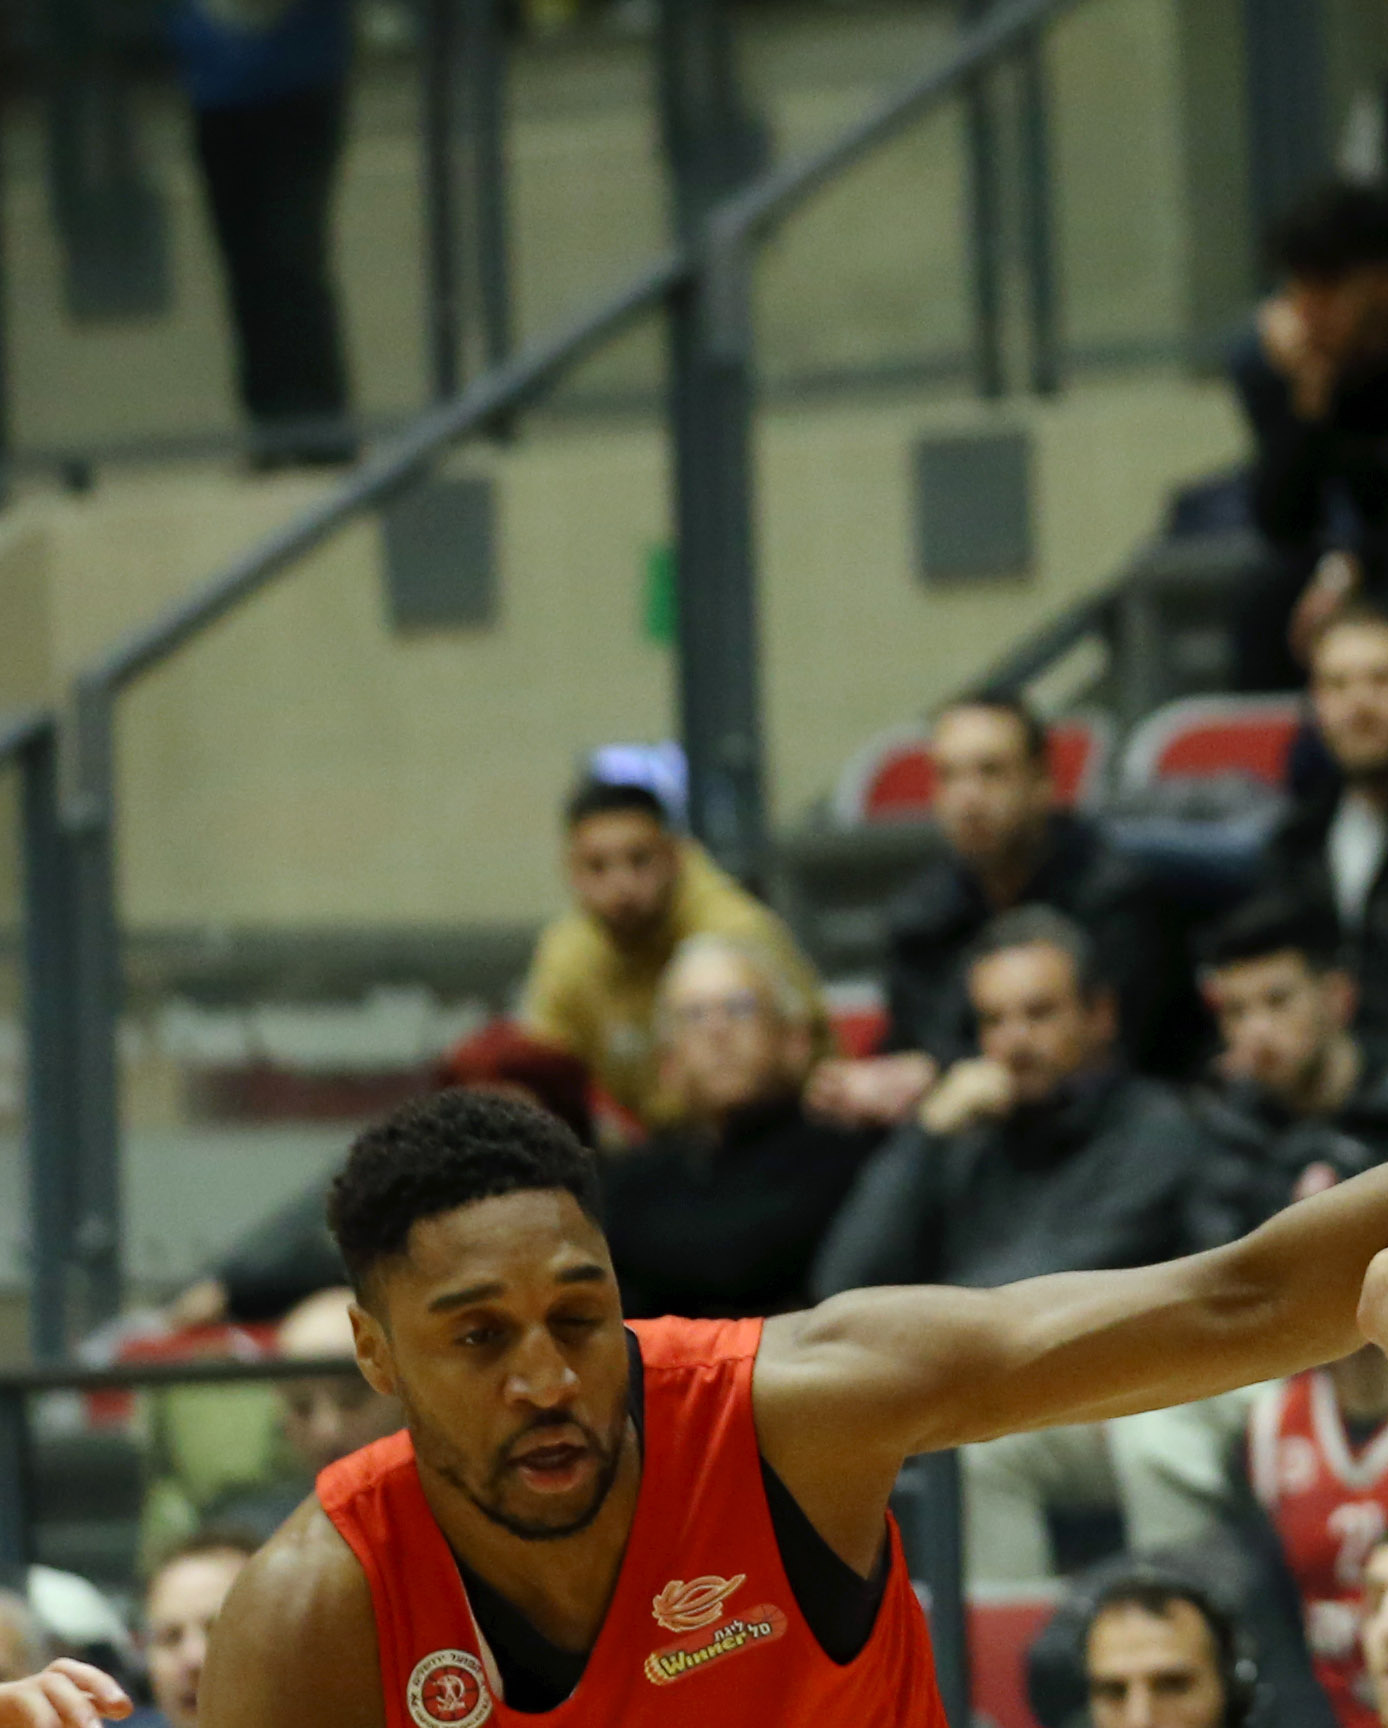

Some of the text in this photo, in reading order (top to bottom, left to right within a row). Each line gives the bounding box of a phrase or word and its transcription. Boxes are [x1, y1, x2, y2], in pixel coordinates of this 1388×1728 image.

[660, 1622, 772, 1676] Winner סל
[714, 1620, 744, 1642] ליגת
